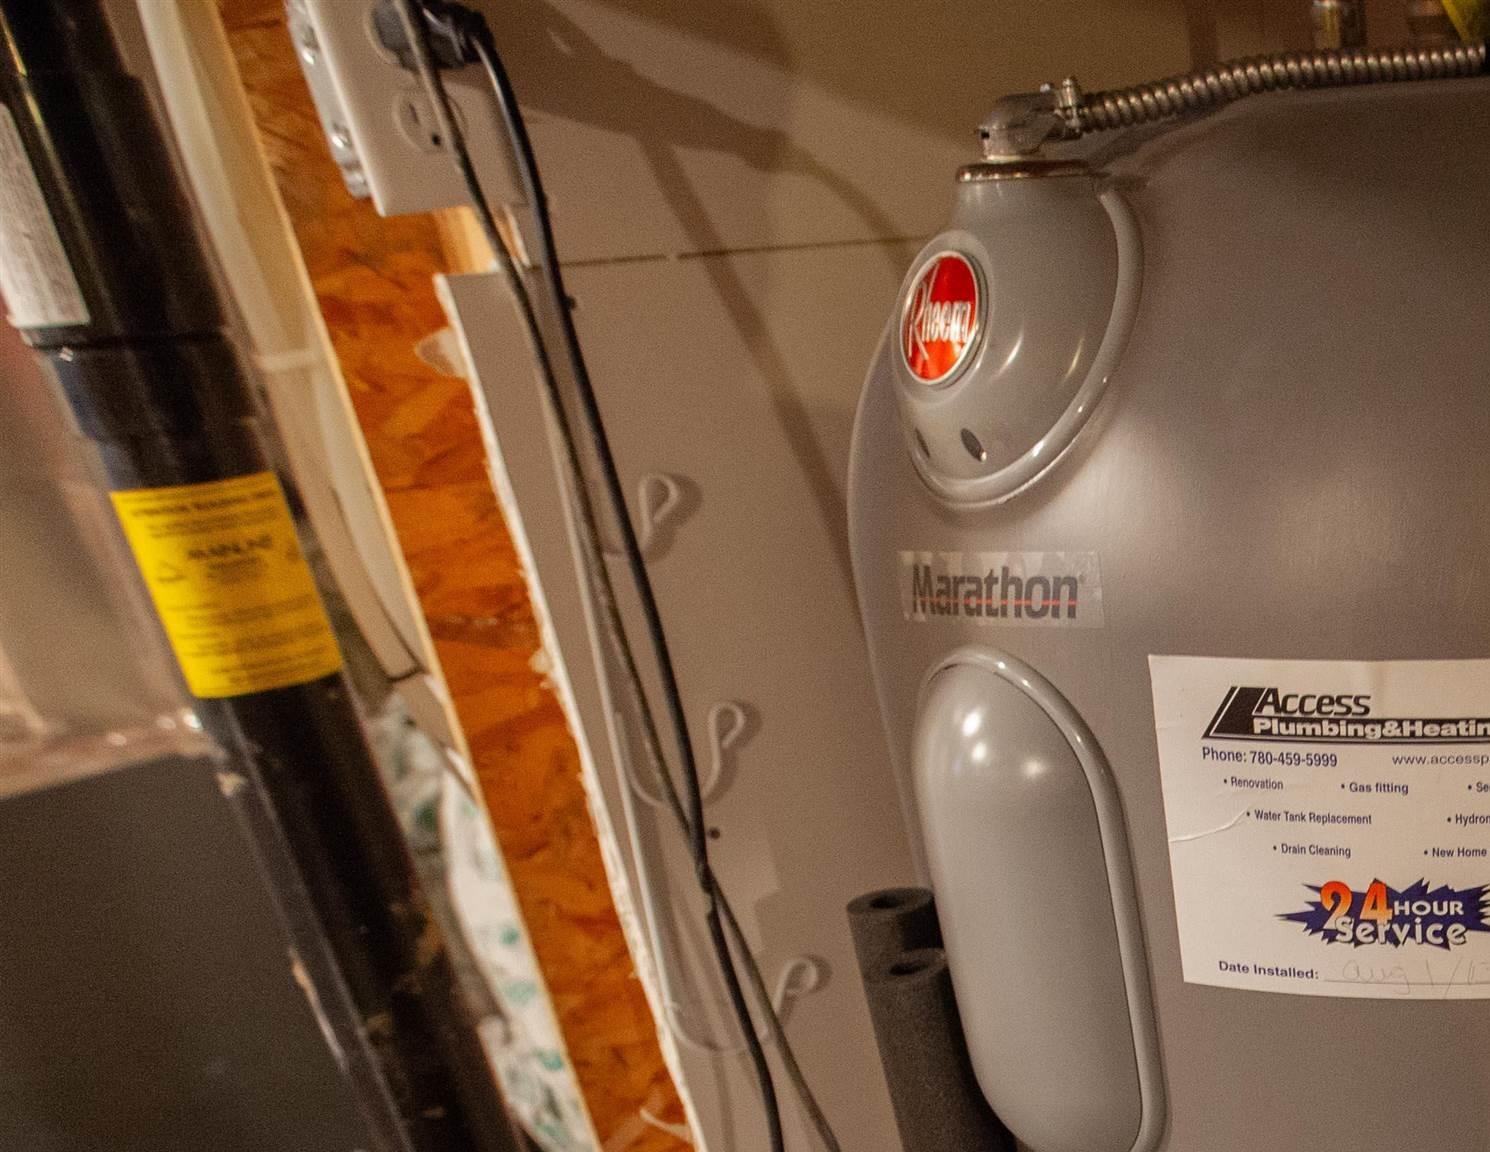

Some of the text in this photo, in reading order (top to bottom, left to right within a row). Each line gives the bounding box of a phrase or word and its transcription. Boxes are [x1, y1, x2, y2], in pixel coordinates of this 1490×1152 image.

[906, 262, 971, 360] Rheem
[912, 563, 1078, 620] Marathon
[1253, 688, 1372, 716] Access
[1201, 746, 1338, 767] Phone: 780-459-5999
[1230, 776, 1284, 790] Renovation
[1349, 781, 1409, 796] Gas fitting
[1254, 809, 1373, 826] Water Tank Replacement
[1281, 843, 1352, 859] Drain Cleaning
[1432, 847, 1454, 858] New
[1457, 846, 1487, 857] Home
[1320, 880, 1465, 930] 24 HOUR
[1334, 916, 1468, 946] Service
[1218, 960, 1320, 980] Date Installed:
